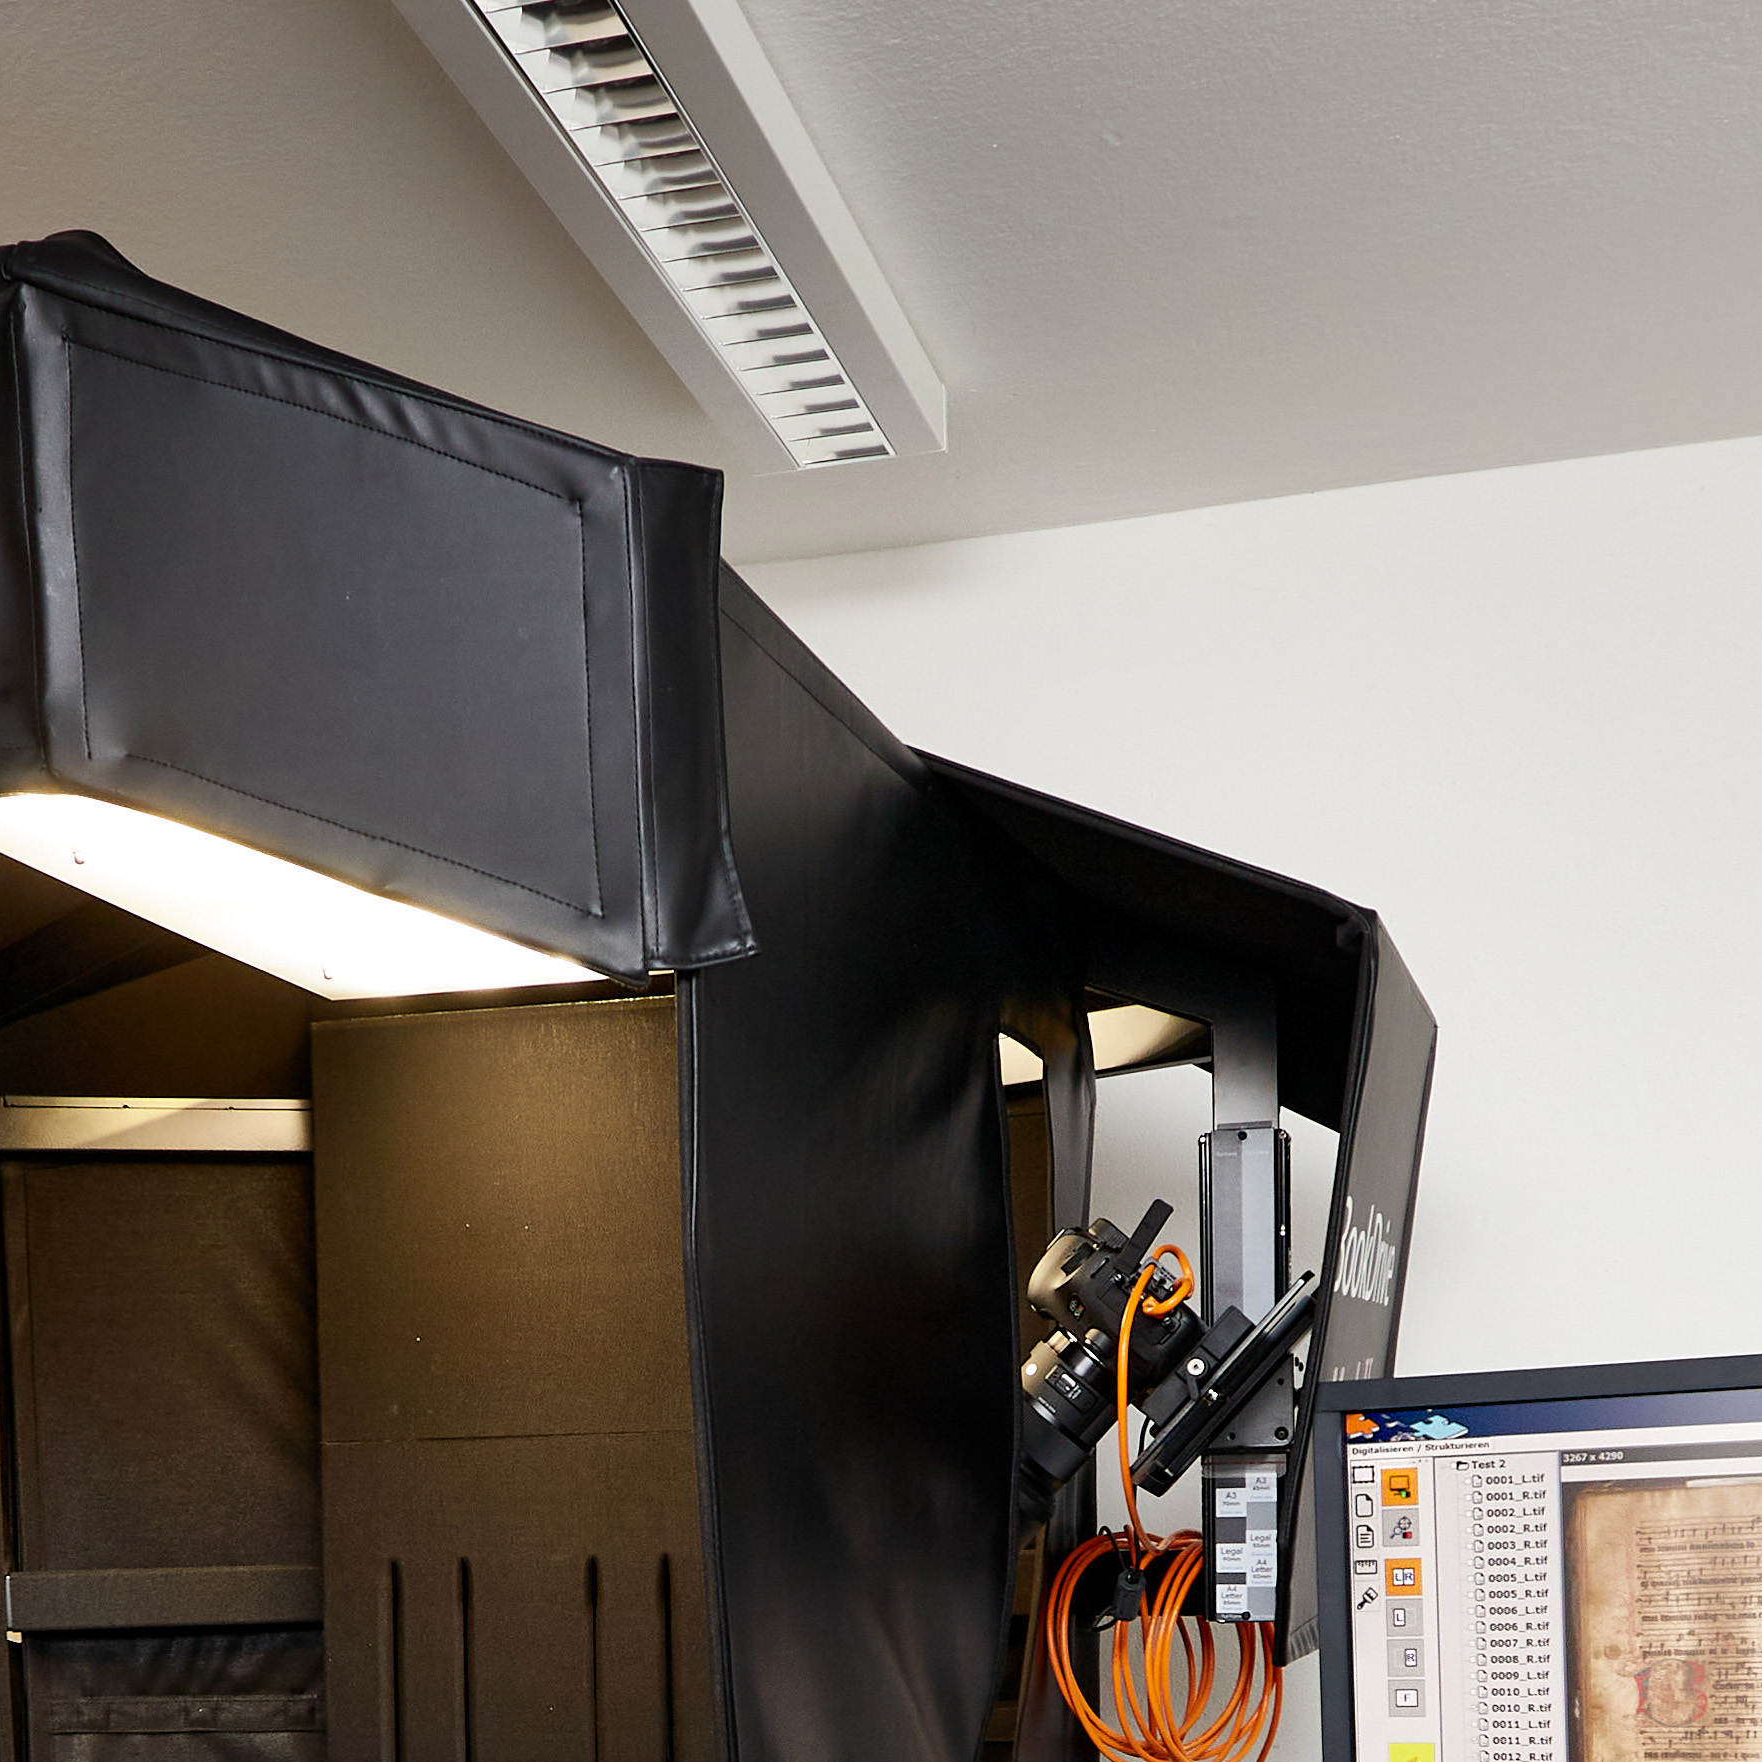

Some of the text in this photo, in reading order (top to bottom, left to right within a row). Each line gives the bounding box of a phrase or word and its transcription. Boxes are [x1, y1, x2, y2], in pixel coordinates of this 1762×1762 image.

[1352, 1443, 1414, 1455] Digitalisieren
[1425, 1440, 1490, 1452] Strukturieren
[1563, 1452, 1587, 1463] 3267
[1471, 1459, 1506, 1470] Test 2
[1250, 1534, 1271, 1542] Legal
[1221, 1547, 1243, 1555] Legal
